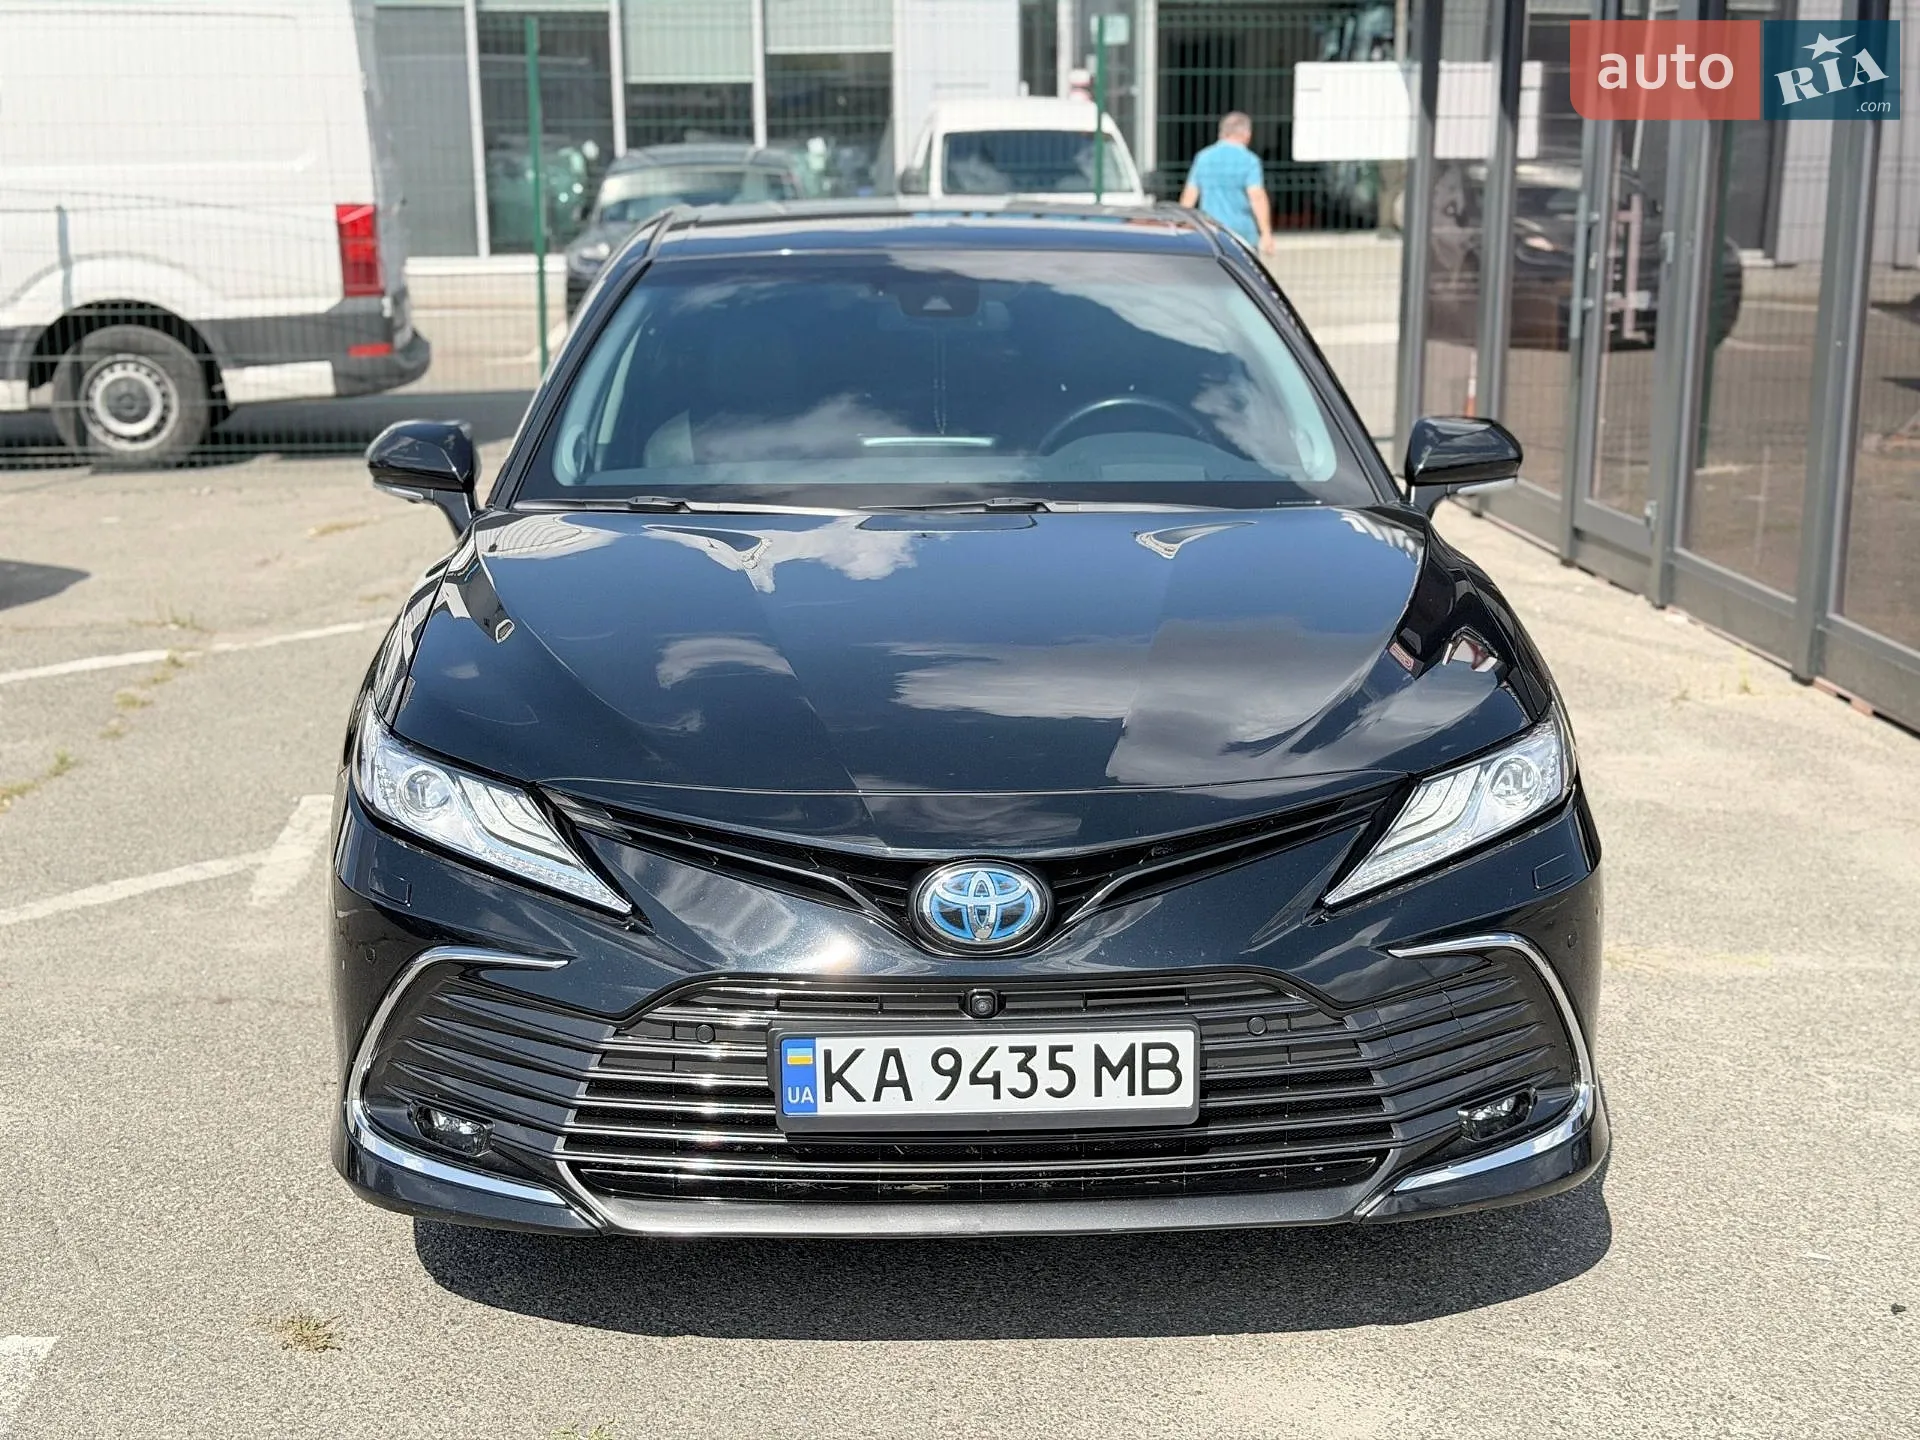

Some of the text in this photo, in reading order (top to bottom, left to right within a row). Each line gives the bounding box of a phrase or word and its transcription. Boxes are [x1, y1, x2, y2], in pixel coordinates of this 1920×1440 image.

[824, 1042, 1182, 1103] KA 9435 MB
[788, 1087, 814, 1105] UA
